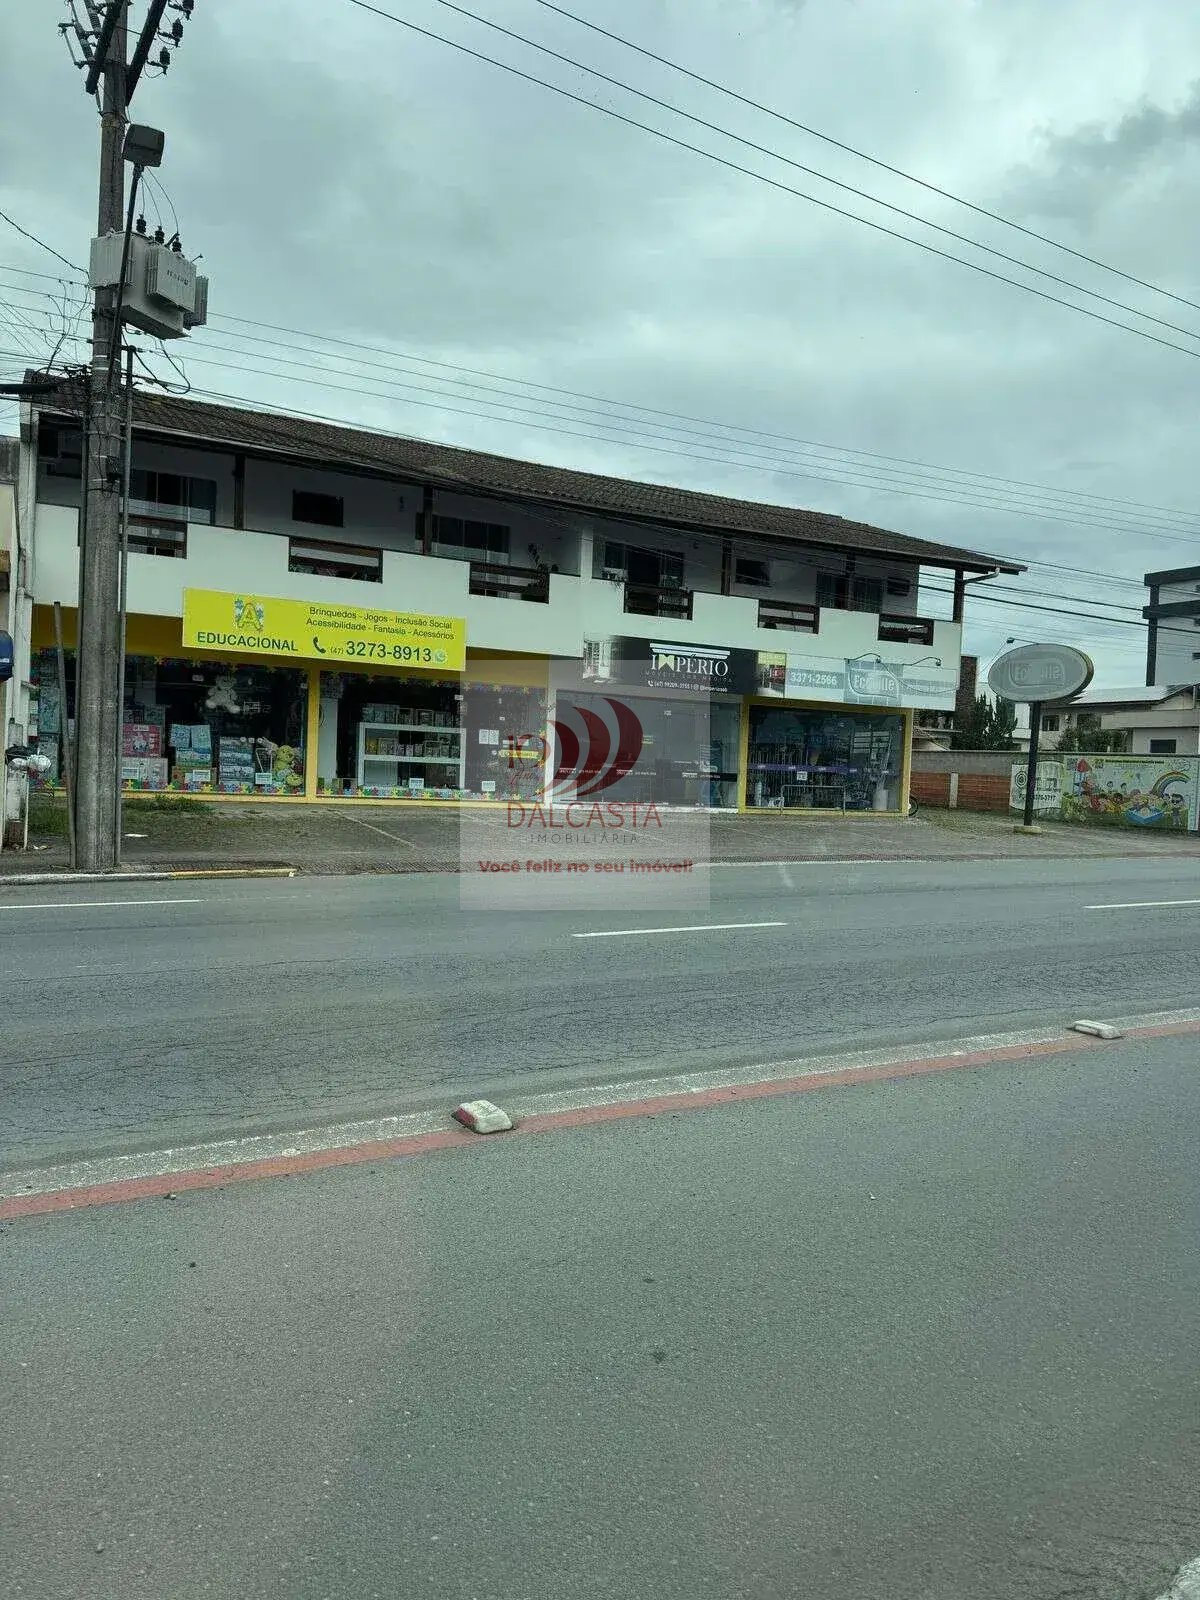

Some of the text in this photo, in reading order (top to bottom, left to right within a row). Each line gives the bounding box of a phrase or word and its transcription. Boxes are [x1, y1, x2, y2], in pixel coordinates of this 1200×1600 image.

[306, 617, 367, 631] Acessibilidade
[373, 624, 406, 635] Fantasia
[413, 629, 455, 640] Acessórios
[309, 606, 357, 619] Brinquedos
[364, 613, 388, 623] Jogos
[395, 615, 428, 627] Inclusão
[429, 619, 452, 629] Social
[197, 631, 299, 652] EDUCACIONAL
[346, 640, 432, 662] 3273-8913
